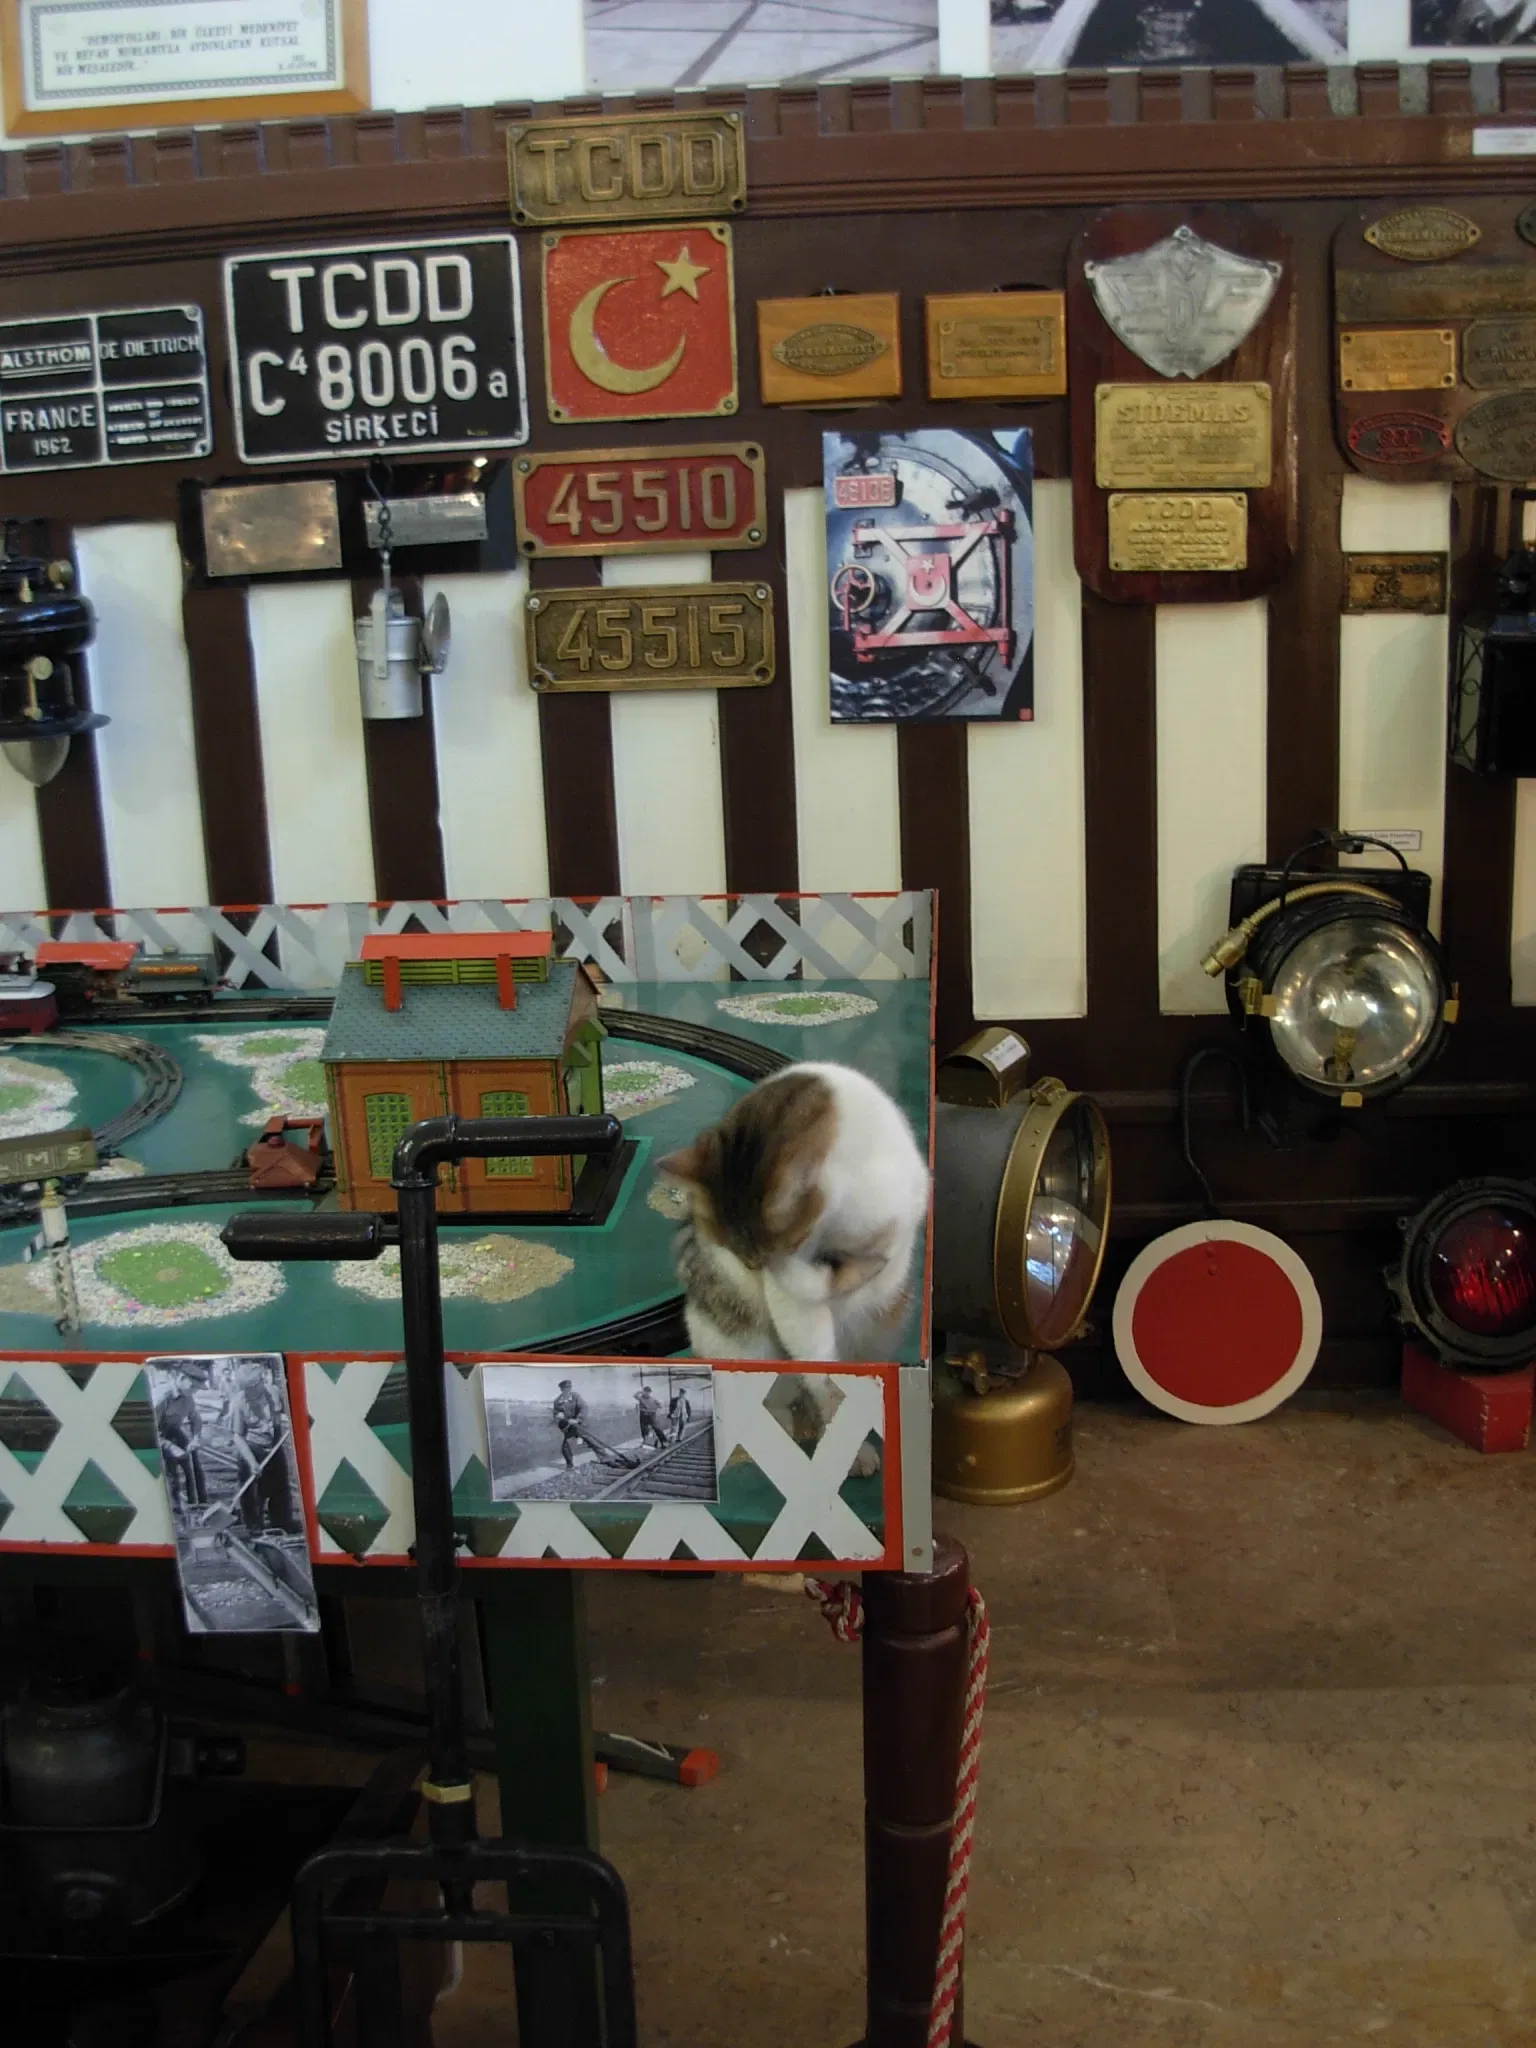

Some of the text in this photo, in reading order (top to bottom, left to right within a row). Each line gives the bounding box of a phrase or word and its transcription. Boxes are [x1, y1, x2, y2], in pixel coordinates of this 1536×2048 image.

[528, 131, 725, 205] TCDD
[268, 254, 474, 333] TCDD
[1, 346, 91, 369] ALSTHOM
[125, 336, 200, 359] DIETRICH
[6, 405, 96, 433] FRANCE
[325, 405, 439, 443] SİRKECİ
[34, 437, 73, 456] 1962
[547, 466, 737, 536] 45510
[556, 604, 747, 672] 45515
